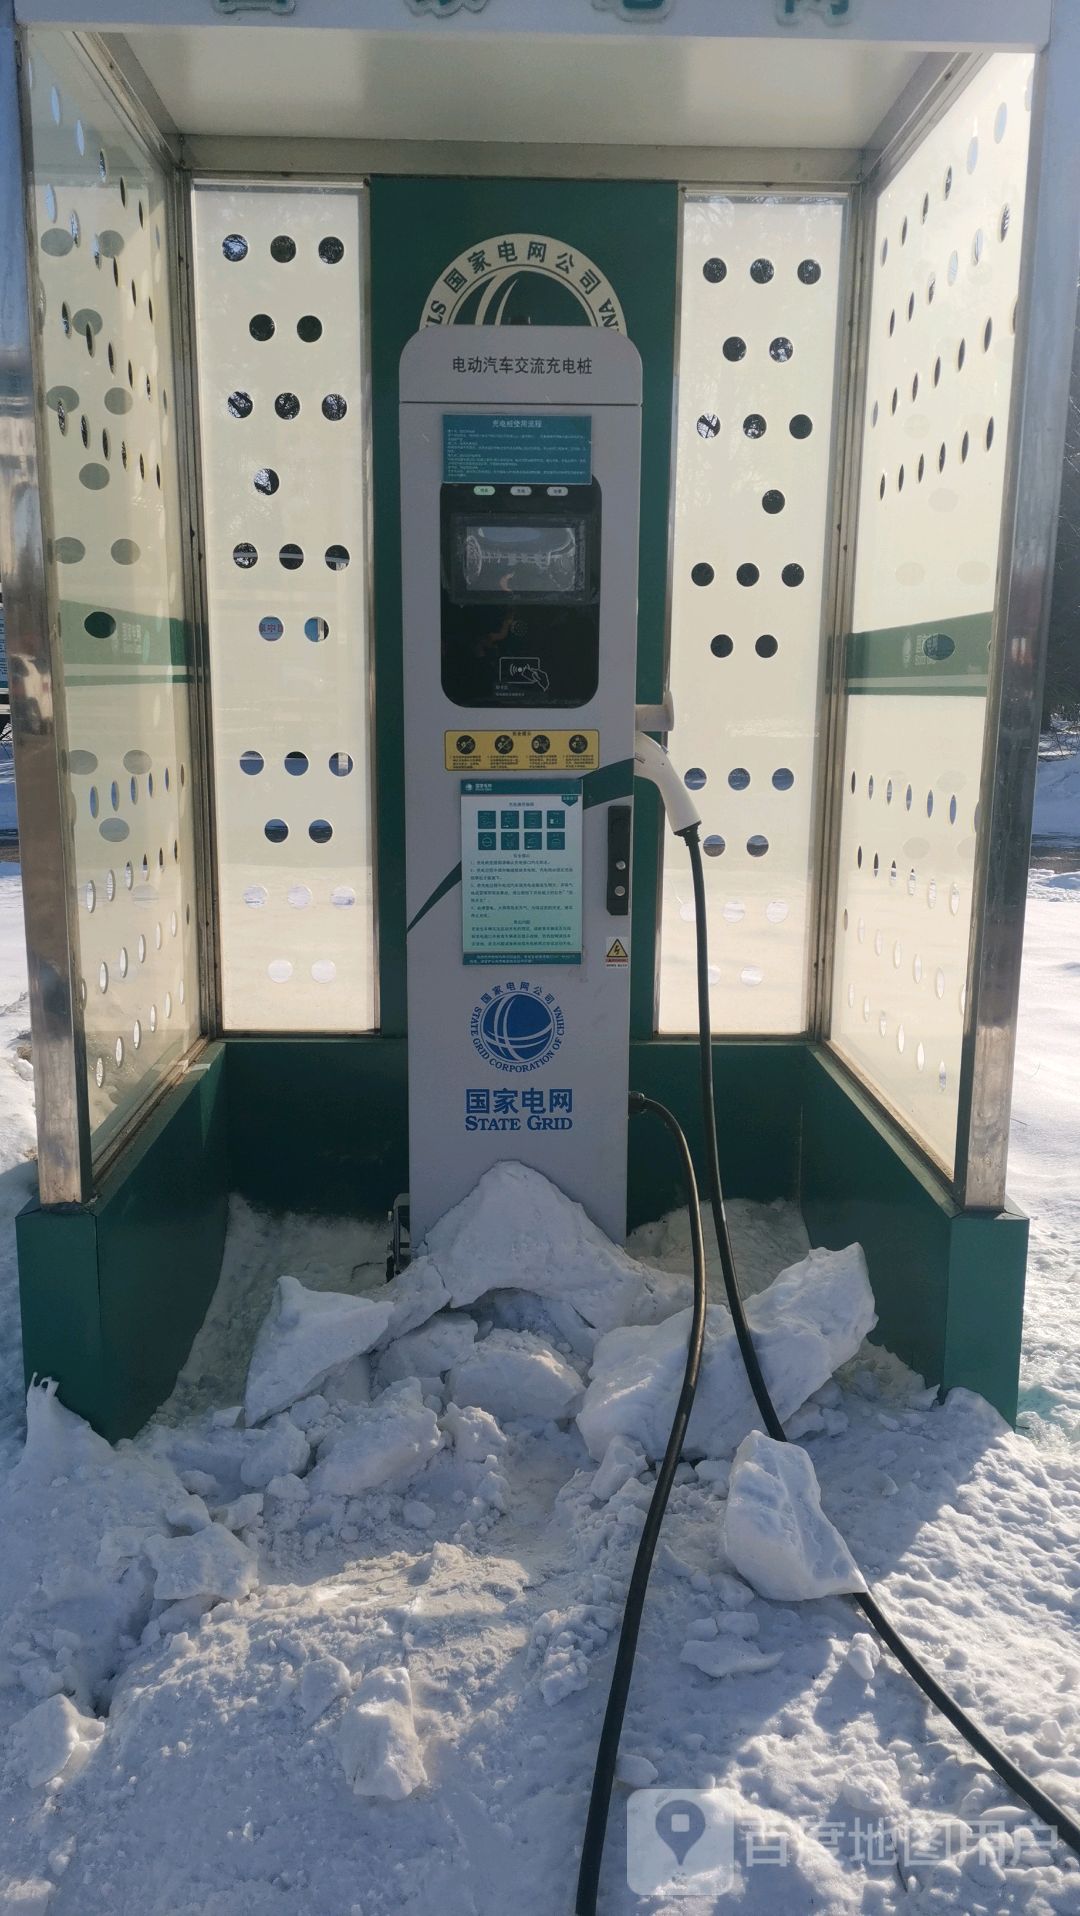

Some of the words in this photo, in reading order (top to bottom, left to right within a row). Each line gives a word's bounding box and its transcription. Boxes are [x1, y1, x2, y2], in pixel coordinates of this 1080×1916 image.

[443, 240, 602, 295] 国家电网公司
[452, 355, 593, 375] 电动汽车交流充电桩
[480, 981, 556, 1004] 国家电网公司
[471, 1006, 482, 1036] STATE
[553, 1006, 565, 1036] CHINA
[472, 1038, 490, 1060] GRID
[552, 1036, 563, 1050] OF
[489, 1051, 555, 1073] CORPORATION
[466, 1087, 573, 1114] 国家电网
[465, 1115, 521, 1131] STATE
[527, 1115, 573, 1131] GRID
